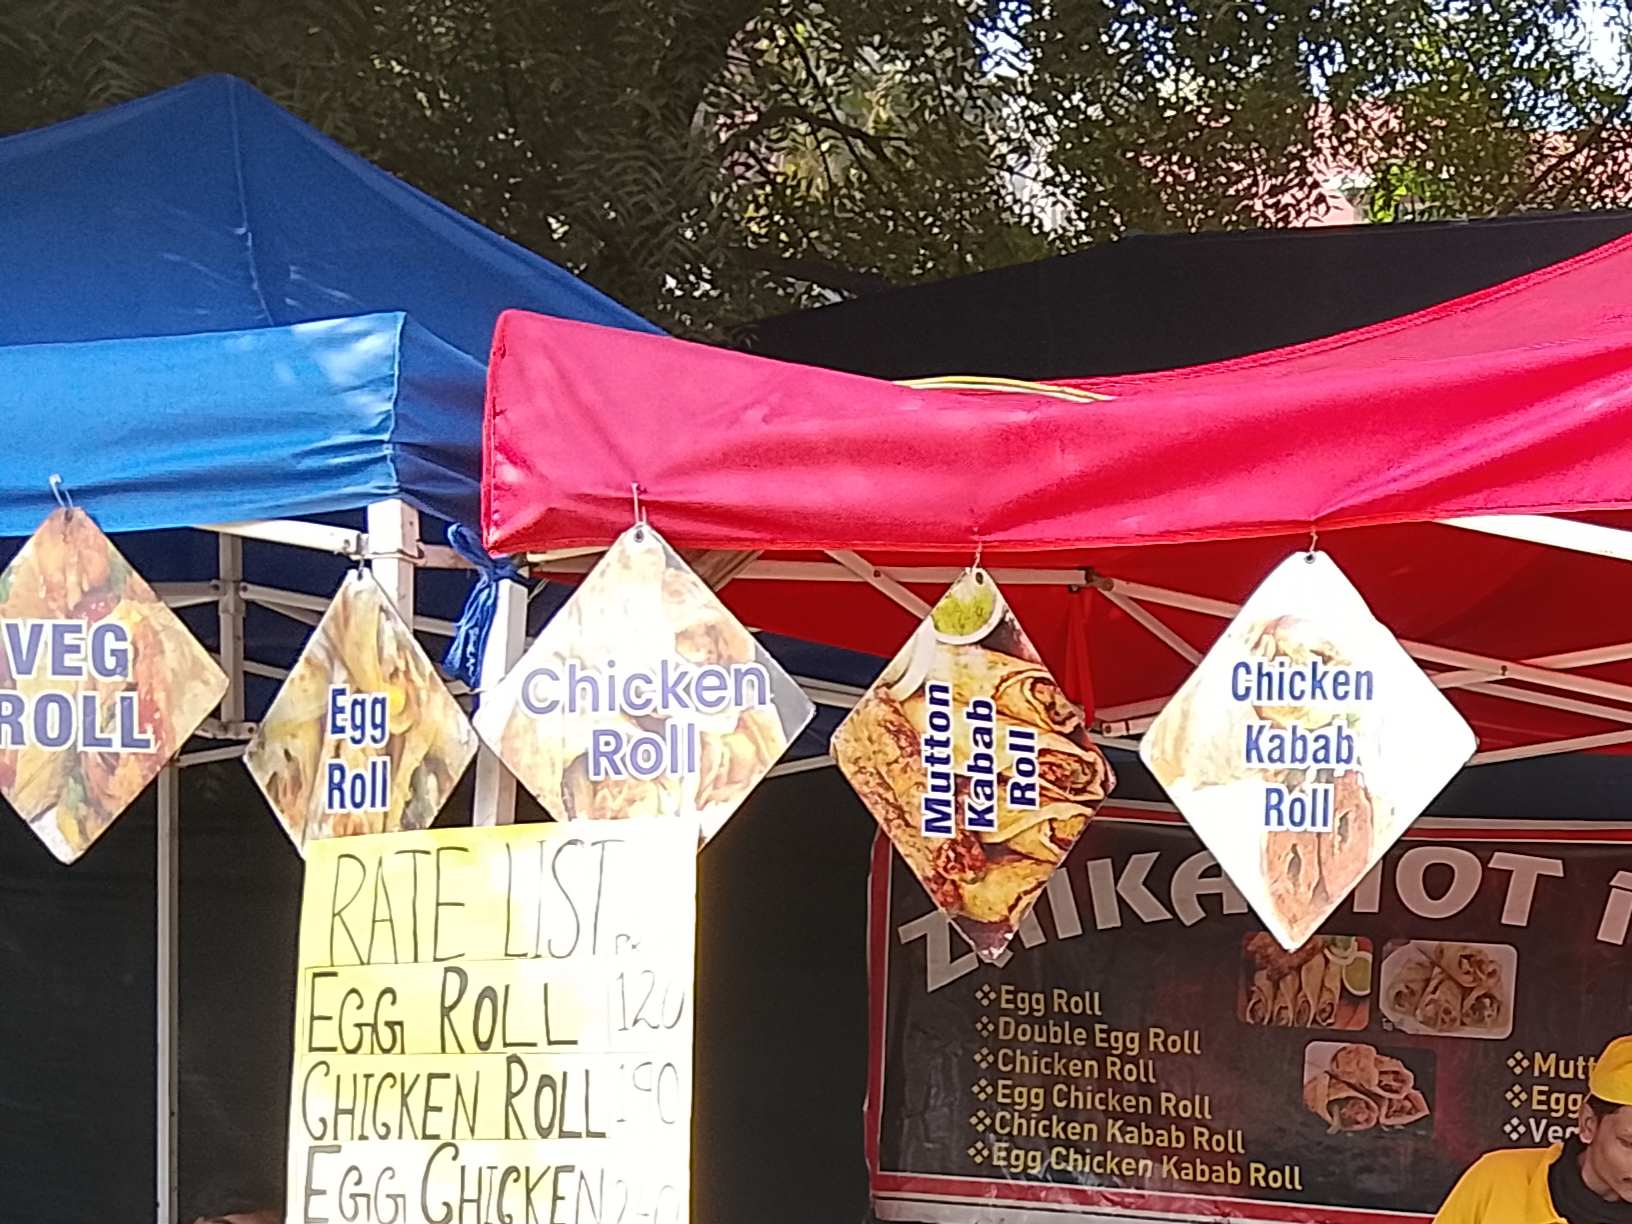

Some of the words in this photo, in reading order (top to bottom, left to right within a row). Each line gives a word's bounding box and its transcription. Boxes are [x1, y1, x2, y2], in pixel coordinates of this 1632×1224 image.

[5, 623, 128, 677] VEG
[521, 662, 768, 716] Chicken
[1233, 661, 1374, 702] Chicken
[0, 693, 150, 748] ROLL
[330, 688, 386, 746] Egg
[592, 724, 697, 779] Roll
[925, 683, 952, 834] Mutton
[968, 698, 994, 828] Kabab
[1010, 728, 1036, 806] Roll
[1246, 724, 1354, 765] Kabab
[328, 761, 388, 810] Roll
[1264, 788, 1331, 829] Roll
[328, 845, 470, 966] RATE
[504, 839, 625, 958] LIST
[309, 971, 406, 1054] EGG
[440, 966, 579, 1054] ROLL
[1001, 985, 1045, 1017] Egg
[1053, 989, 1102, 1016] Roll
[999, 1016, 1087, 1046] Double
[1094, 1024, 1139, 1056] Egg
[1149, 1028, 1201, 1055] Roll
[998, 1049, 1099, 1080] Chicken
[1107, 1057, 1156, 1083] Roll
[1534, 1053, 1596, 1080] Mutt
[301, 1060, 480, 1141] CHICKEN
[505, 1054, 608, 1139] ROLL
[997, 1080, 1044, 1111] Egg
[1052, 1084, 1151, 1114] Chicken
[1160, 1092, 1212, 1120] Roll
[1532, 1085, 1582, 1117] Egg
[994, 1111, 1098, 1142] Chicken
[1106, 1119, 1185, 1149] Kabab
[1193, 1127, 1245, 1154] Roll
[303, 1145, 406, 1224] EGG
[992, 1142, 1042, 1174] Egg
[1051, 1146, 1153, 1178] Chicken
[1162, 1156, 1241, 1185] Kabab
[1250, 1162, 1303, 1190] Roll
